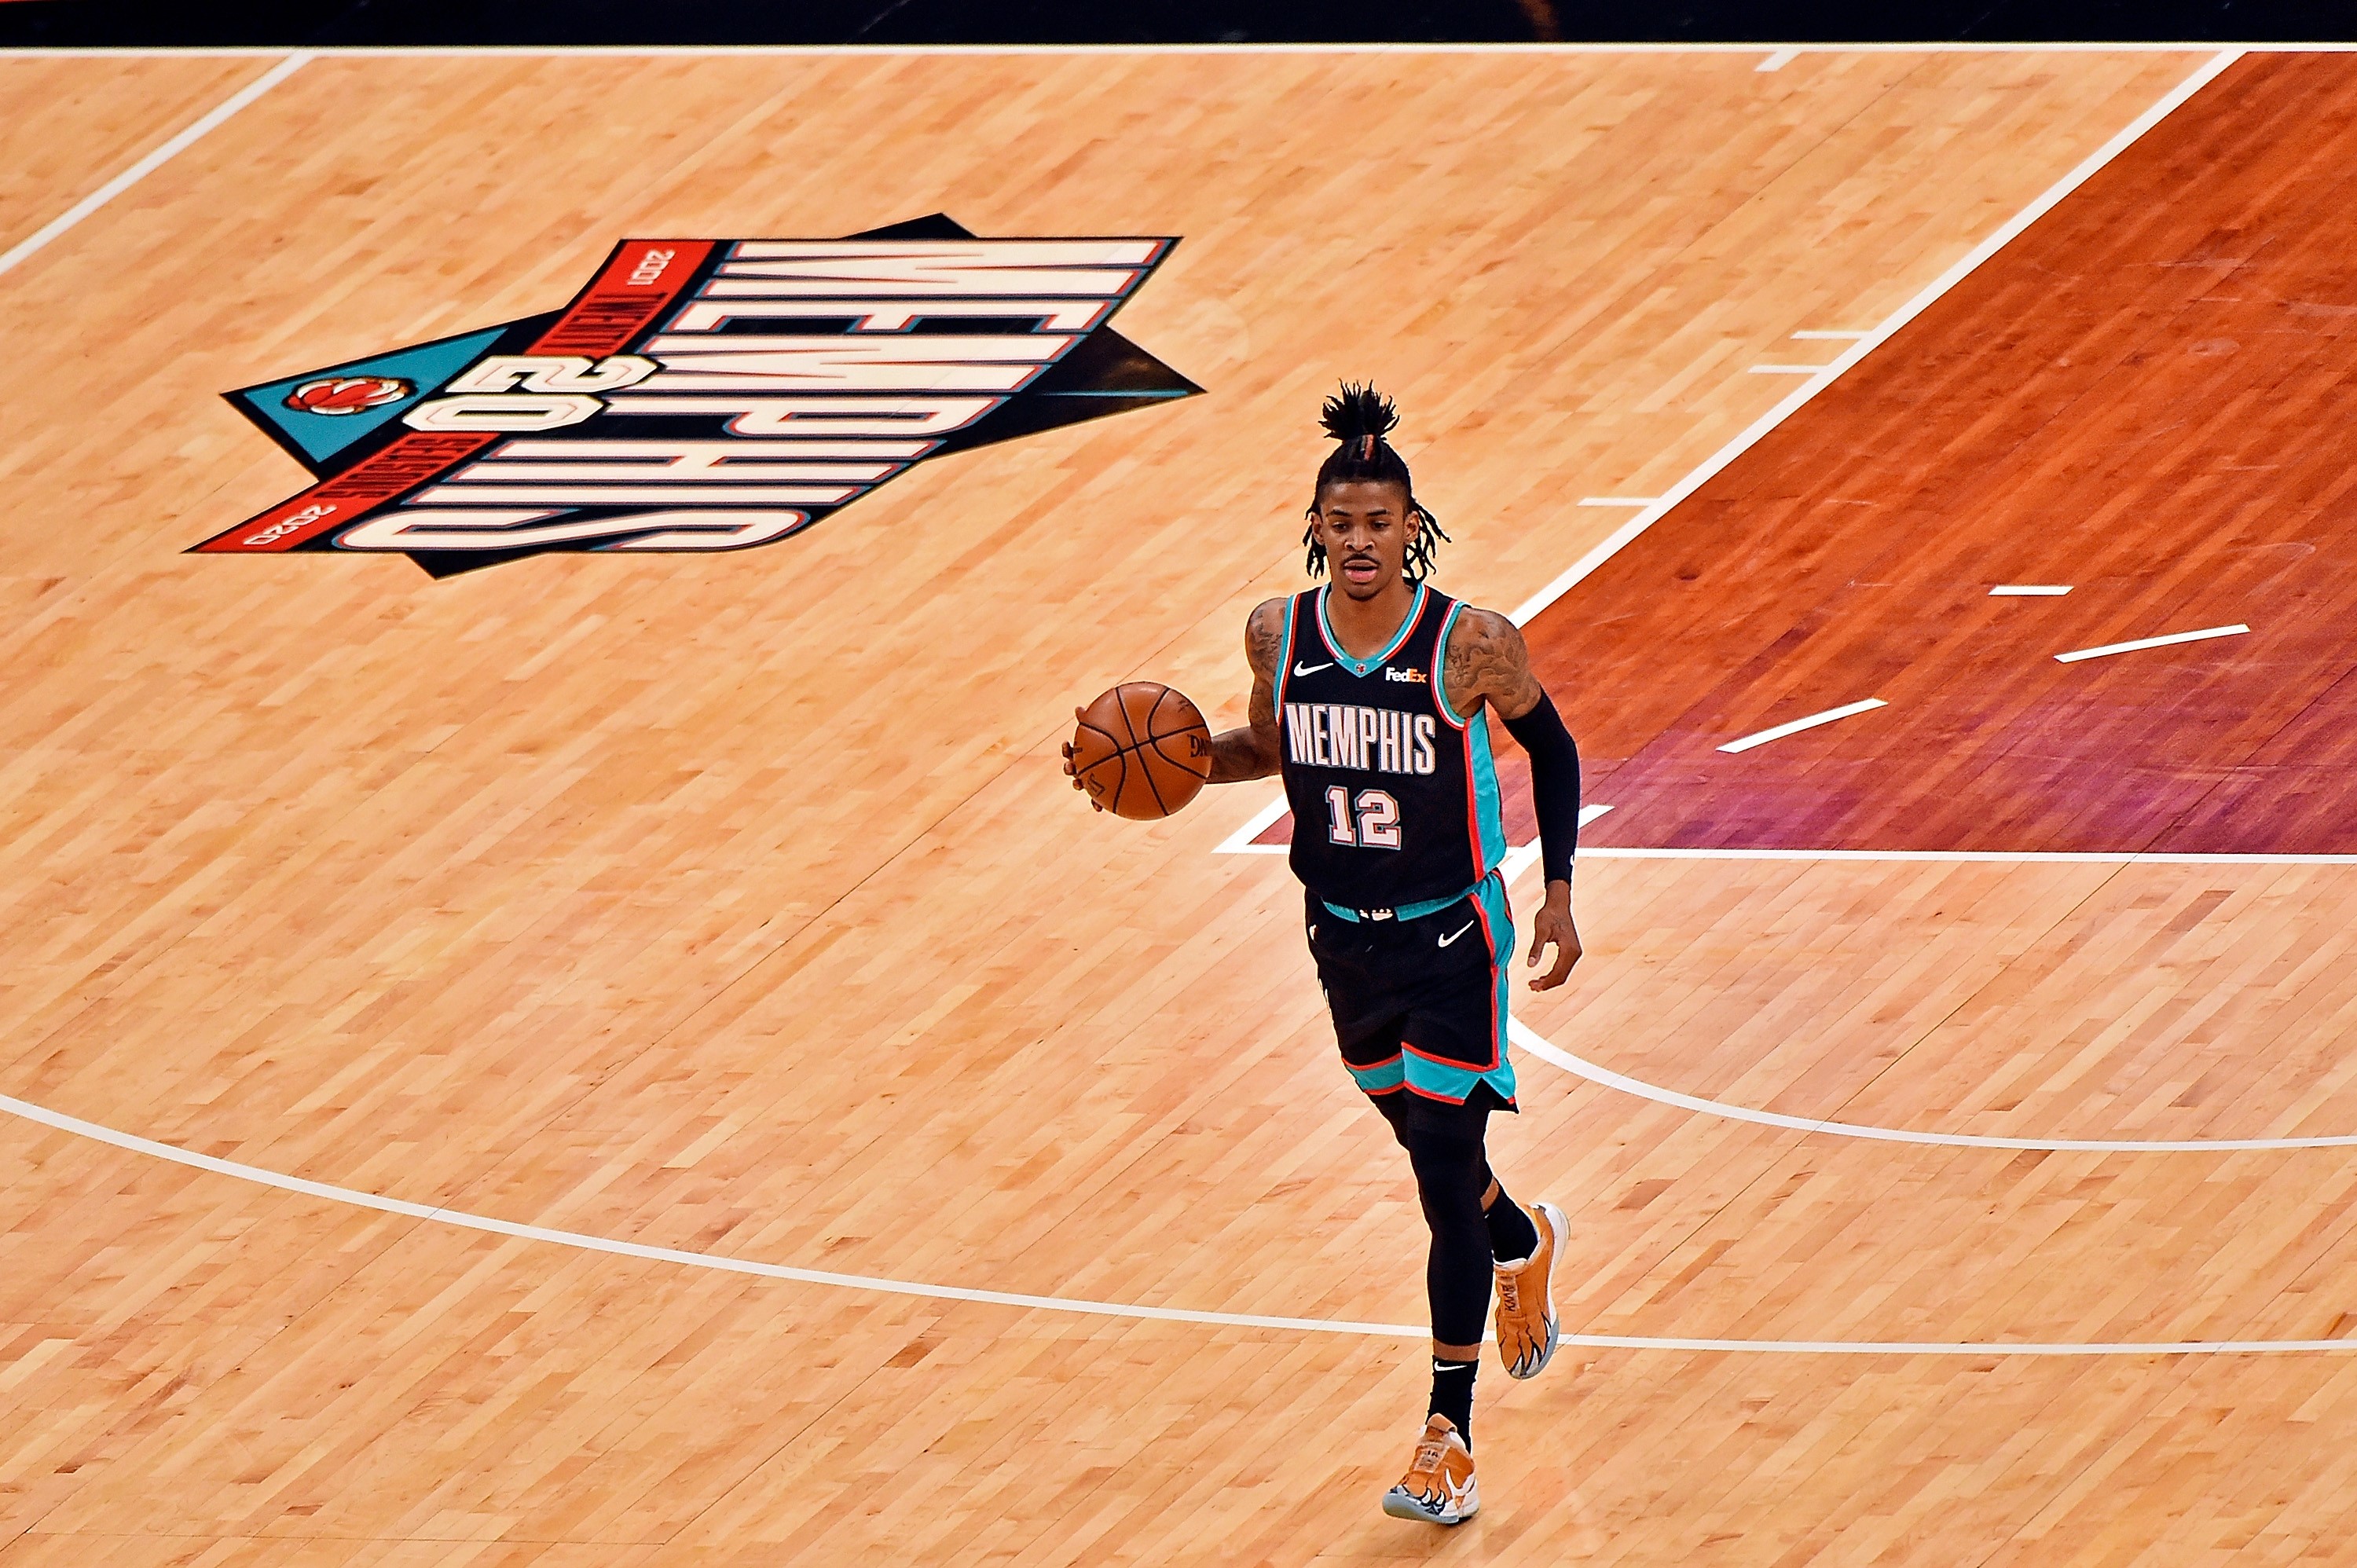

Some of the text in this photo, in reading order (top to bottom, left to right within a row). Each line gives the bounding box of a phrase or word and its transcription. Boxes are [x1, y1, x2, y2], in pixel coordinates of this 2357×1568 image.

[626, 249, 676, 286] 2001
[332, 238, 1178, 551] MEMPHIS
[402, 355, 661, 432] 20
[313, 438, 482, 499] SEASONS
[242, 504, 338, 545] 2020
[1385, 666, 1428, 683] FedEx
[1284, 702, 1436, 775] MEMPHIS
[1325, 784, 1402, 851] 12
